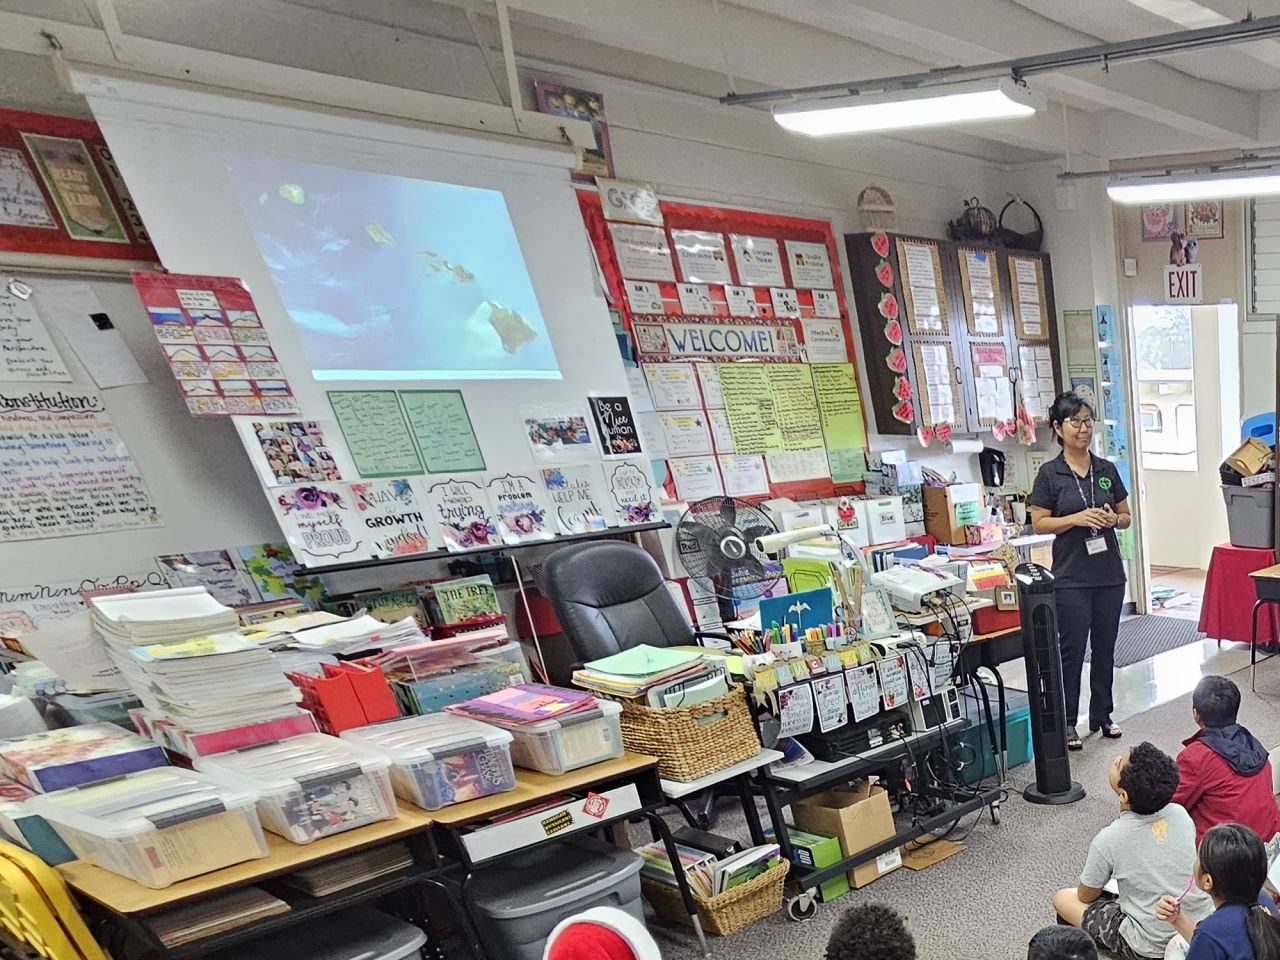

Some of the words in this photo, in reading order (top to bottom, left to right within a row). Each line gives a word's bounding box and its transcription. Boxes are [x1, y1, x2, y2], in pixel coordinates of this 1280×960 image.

[1168, 270, 1198, 298] EXIT
[667, 328, 775, 353] WELCOME!
[614, 403, 623, 412] a
[605, 425, 633, 436] uman
[365, 511, 424, 529] GROWTH
[437, 503, 486, 521] trying
[881, 514, 894, 522] Blue
[298, 513, 343, 534] myself
[839, 521, 857, 529] Green
[301, 528, 351, 550] PROUD
[681, 541, 697, 550] Red
[442, 588, 463, 601] THE
[465, 585, 490, 597] TREE
